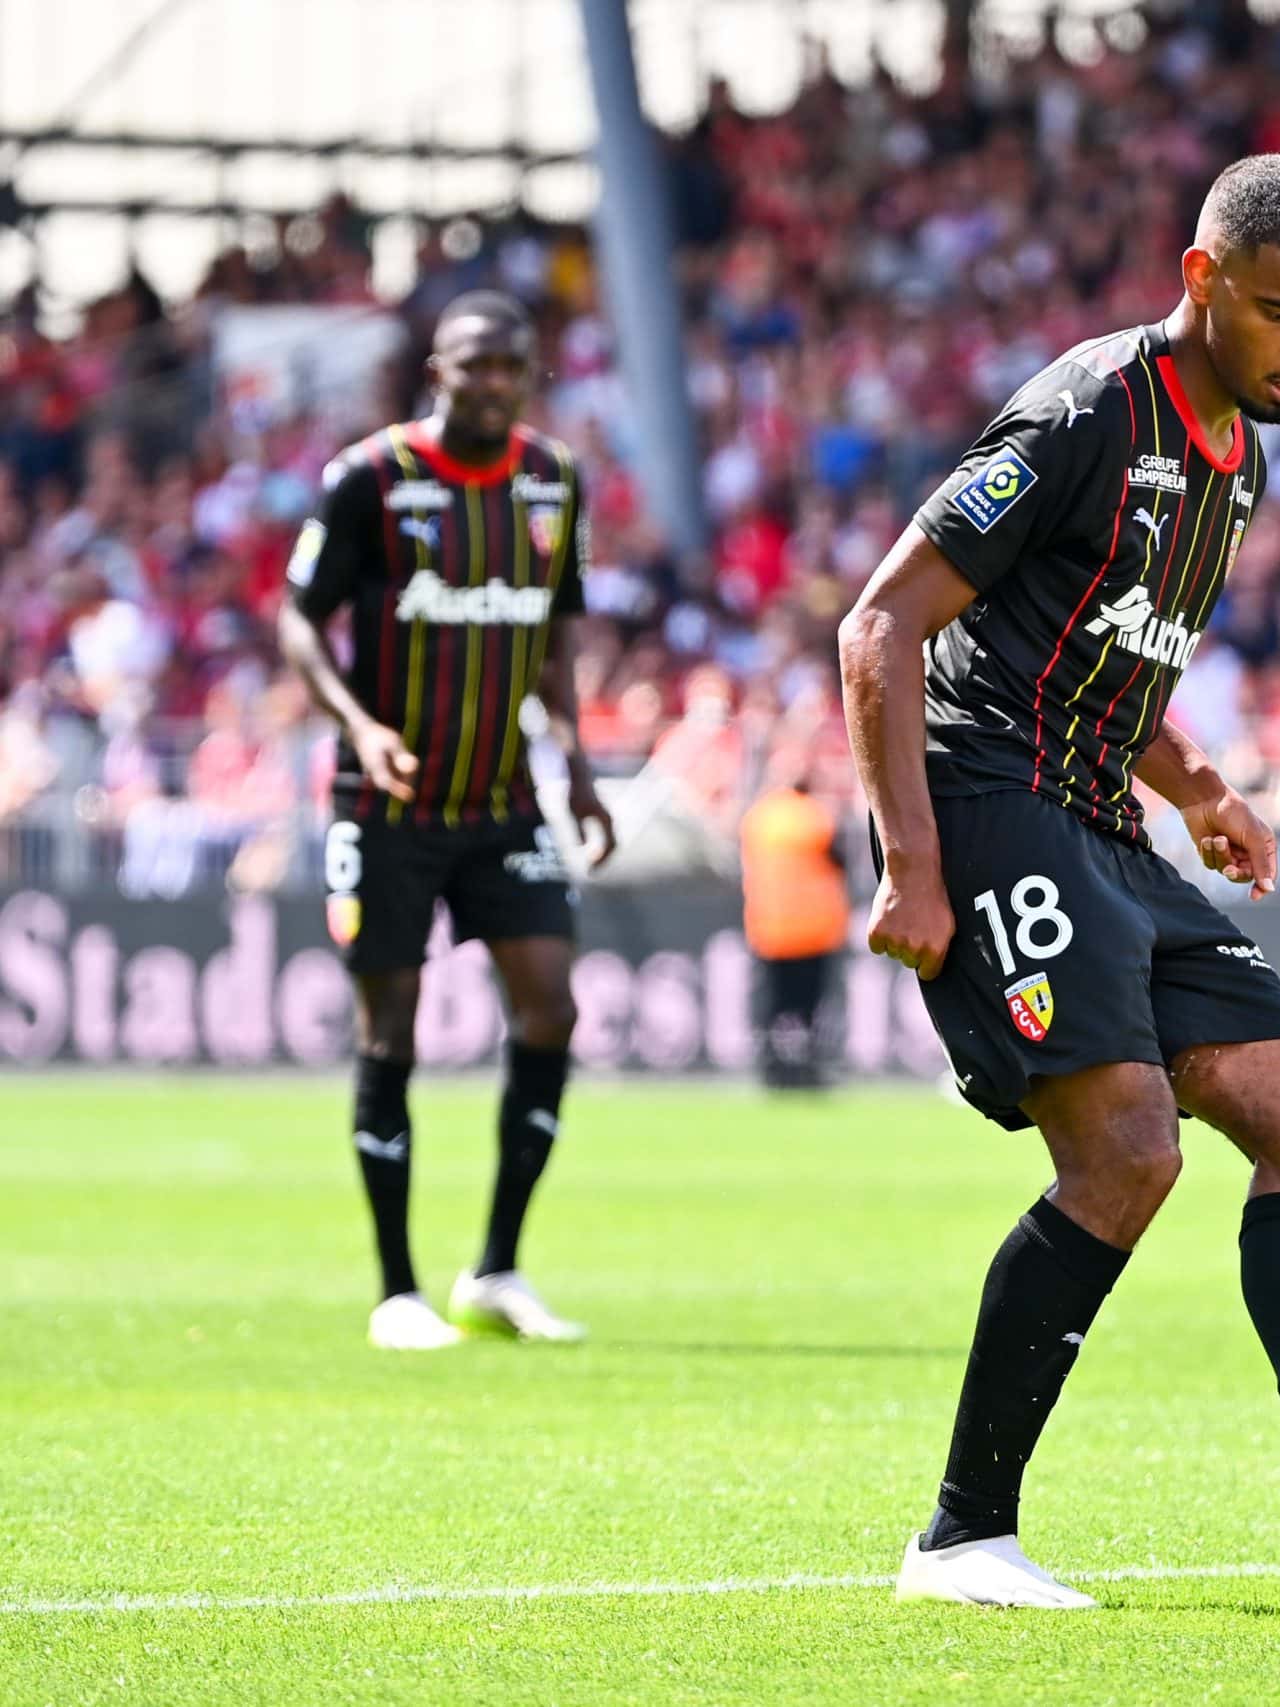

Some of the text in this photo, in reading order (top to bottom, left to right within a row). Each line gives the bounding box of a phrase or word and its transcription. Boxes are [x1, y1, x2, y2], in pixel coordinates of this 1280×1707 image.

[1139, 454, 1181, 475] GROUPE
[968, 485, 992, 510] LIGUE
[325, 820, 363, 892] 6
[974, 875, 1074, 975] 18
[0, 889, 356, 1068] Stade
[1011, 998, 1042, 1038] RCL
